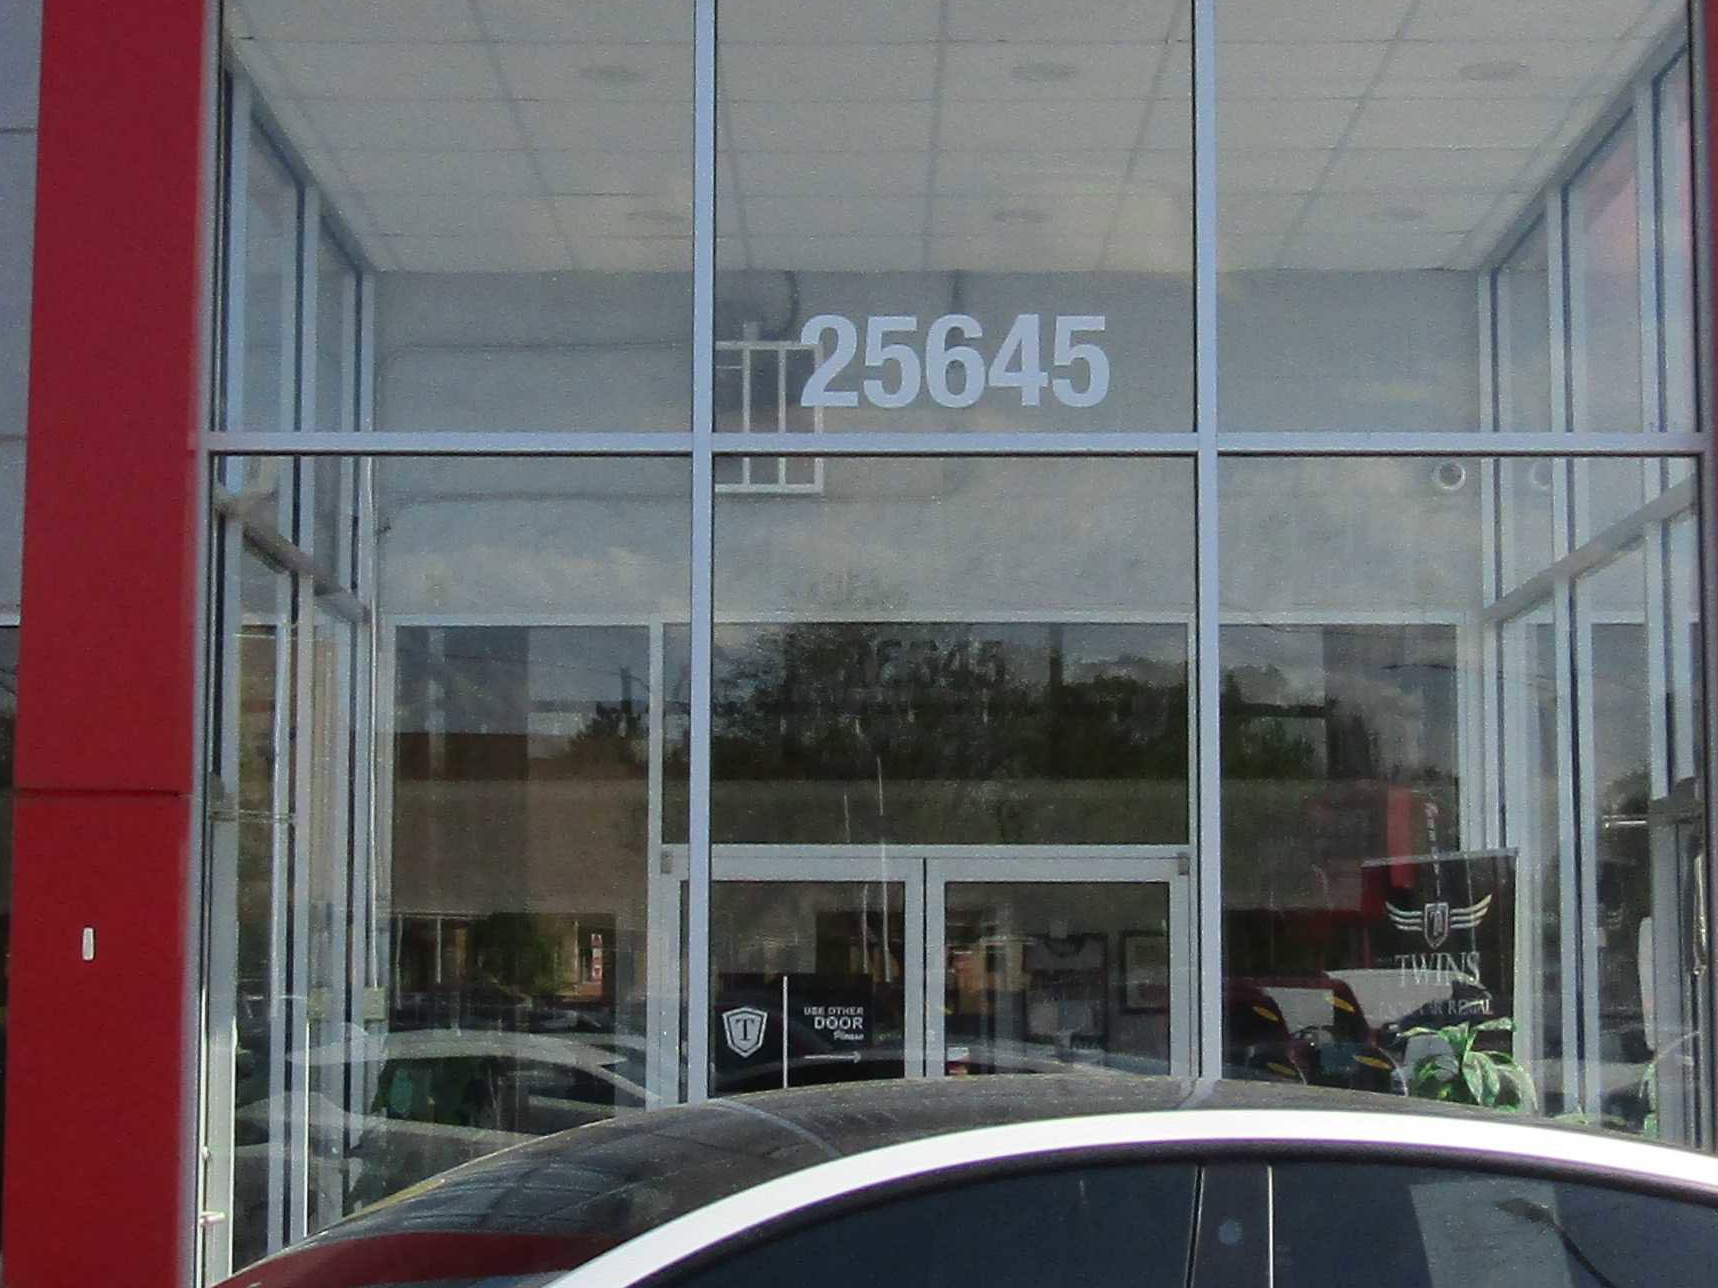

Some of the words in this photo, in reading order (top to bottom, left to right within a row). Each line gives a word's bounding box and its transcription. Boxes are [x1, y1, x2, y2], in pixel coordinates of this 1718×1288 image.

[800, 313, 1111, 408] 25645
[1395, 951, 1481, 988] TWINS
[804, 1006, 824, 1016] USE
[828, 1006, 864, 1016] OTHER
[814, 1016, 864, 1029] DOOR
[735, 1018, 756, 1042] T
